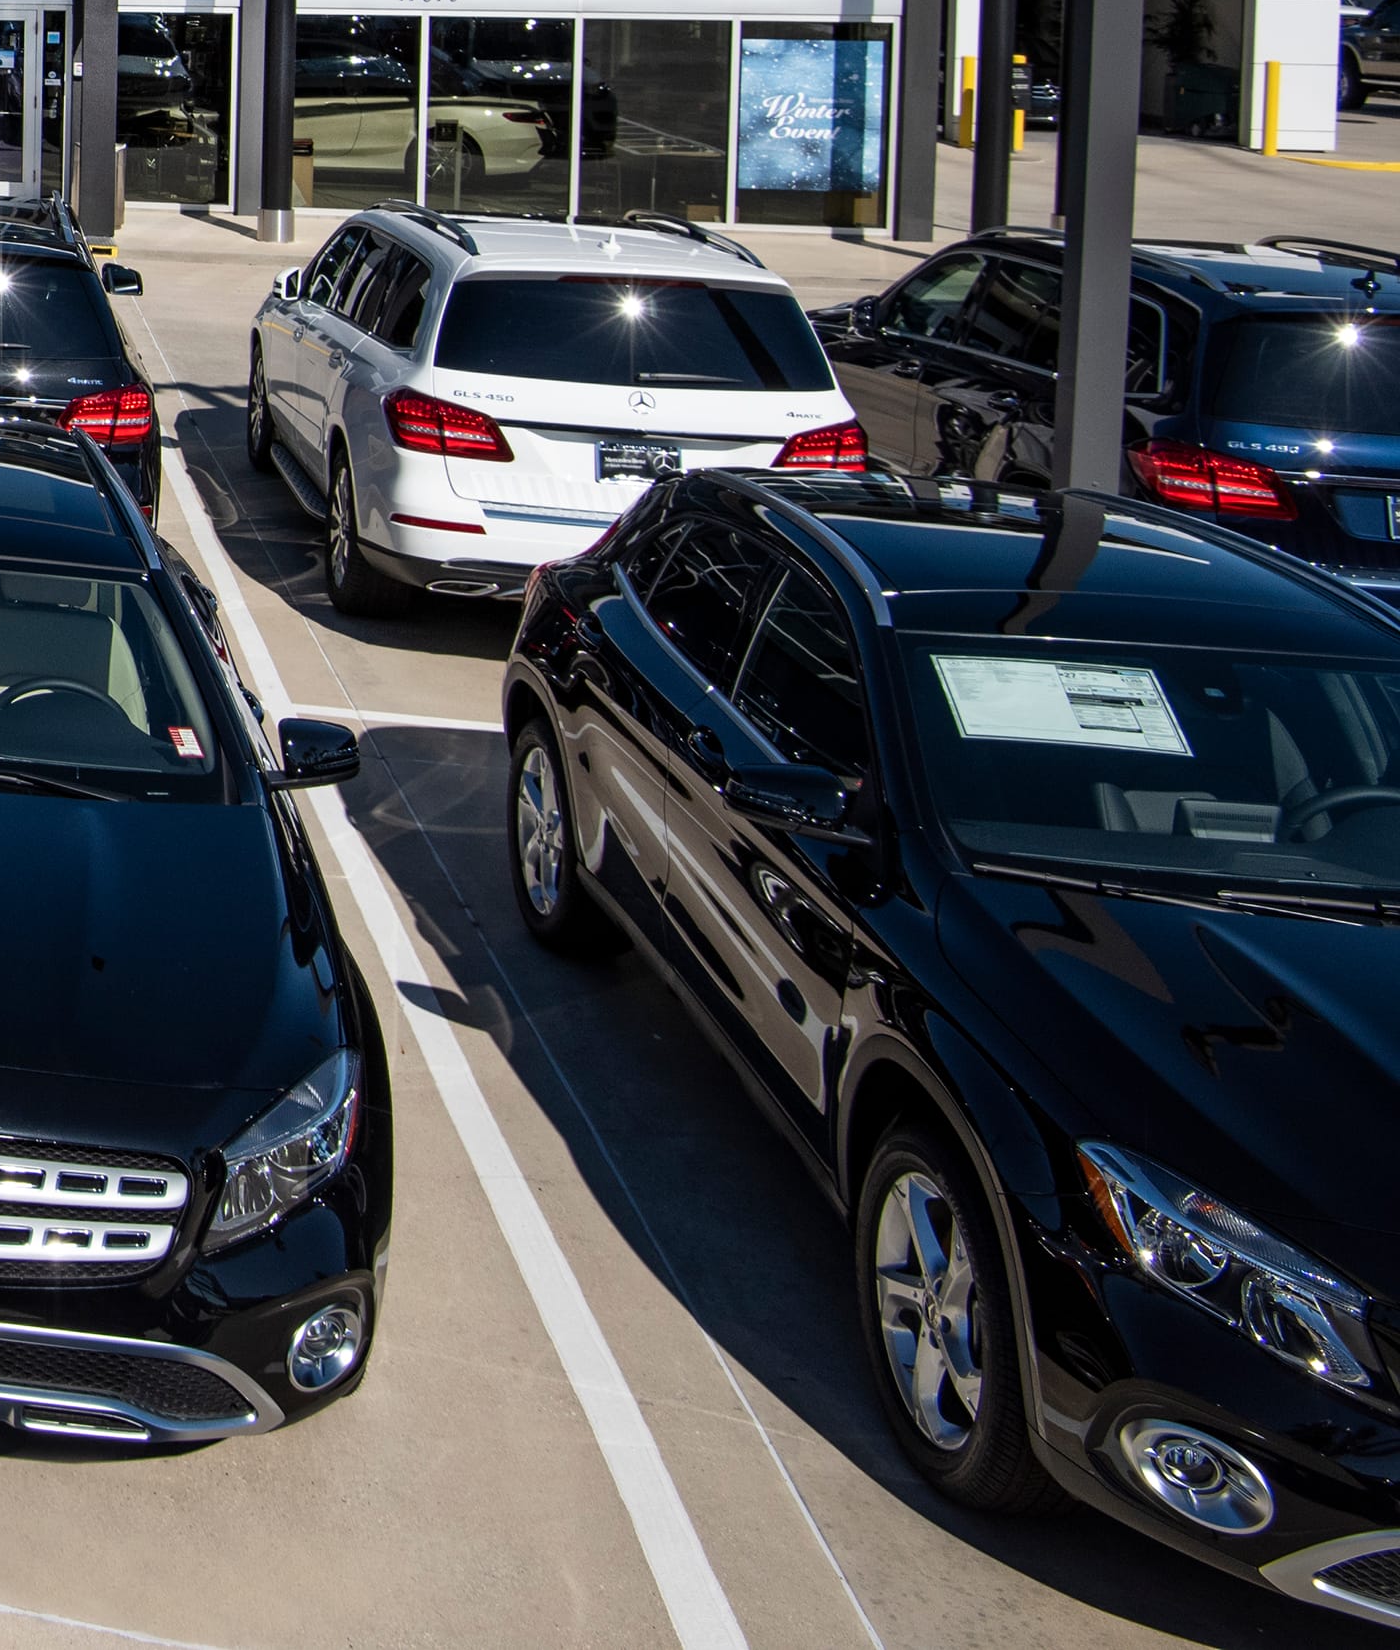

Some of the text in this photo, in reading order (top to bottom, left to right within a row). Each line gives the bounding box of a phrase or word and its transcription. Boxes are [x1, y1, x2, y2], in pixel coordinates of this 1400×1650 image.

[762, 92, 852, 119] Winter
[769, 115, 842, 140] Event
[453, 389, 515, 403] GLS 450
[1226, 440, 1262, 451] GLS
